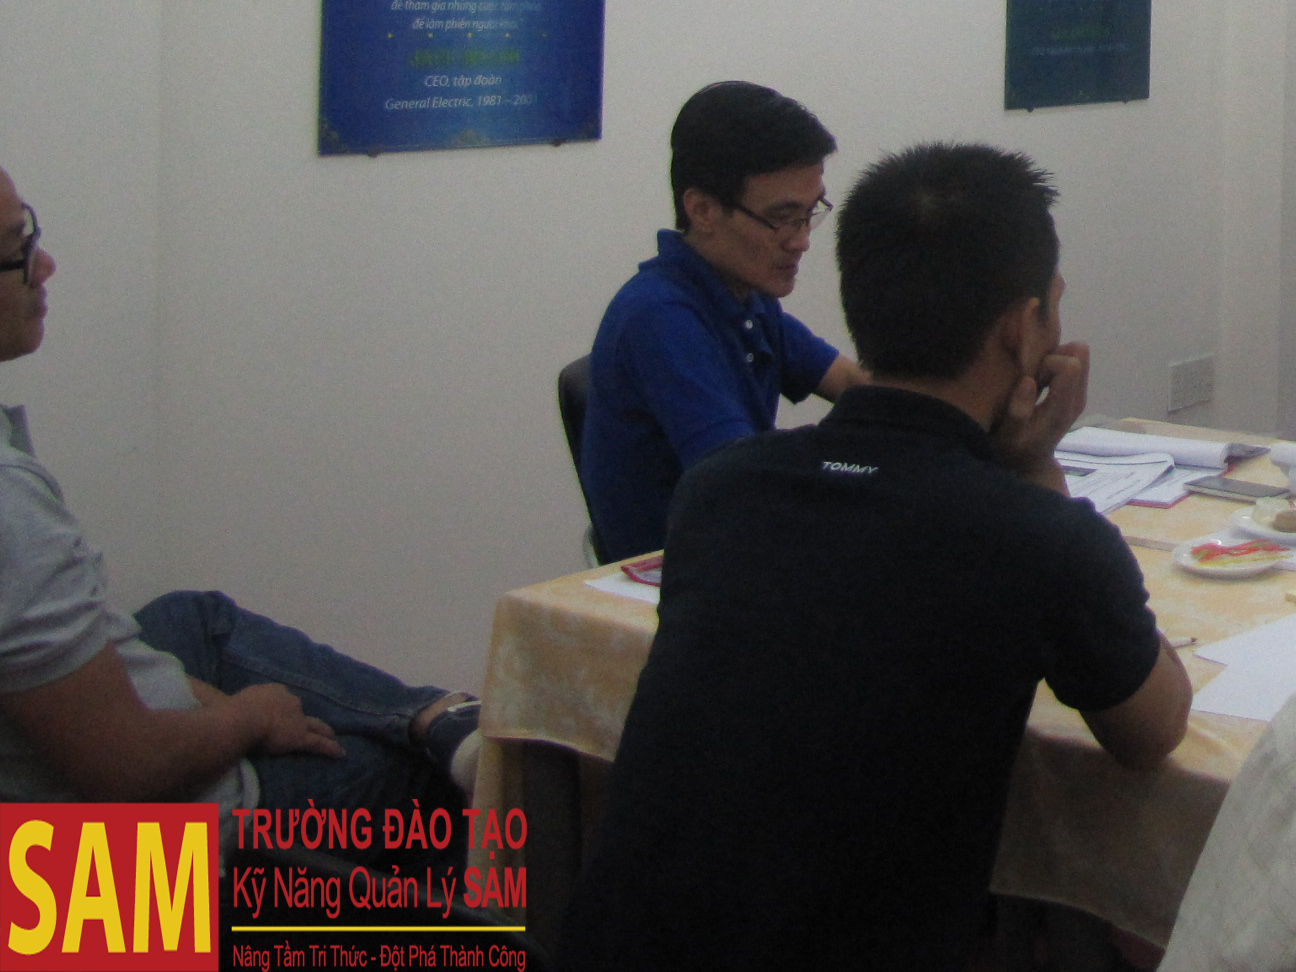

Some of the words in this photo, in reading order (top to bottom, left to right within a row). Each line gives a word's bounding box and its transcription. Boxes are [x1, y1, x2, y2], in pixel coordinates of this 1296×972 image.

[424, 75, 450, 88] CEO,
[384, 97, 430, 111] General
[432, 95, 474, 109] Electric,
[823, 461, 879, 474] TOMMY
